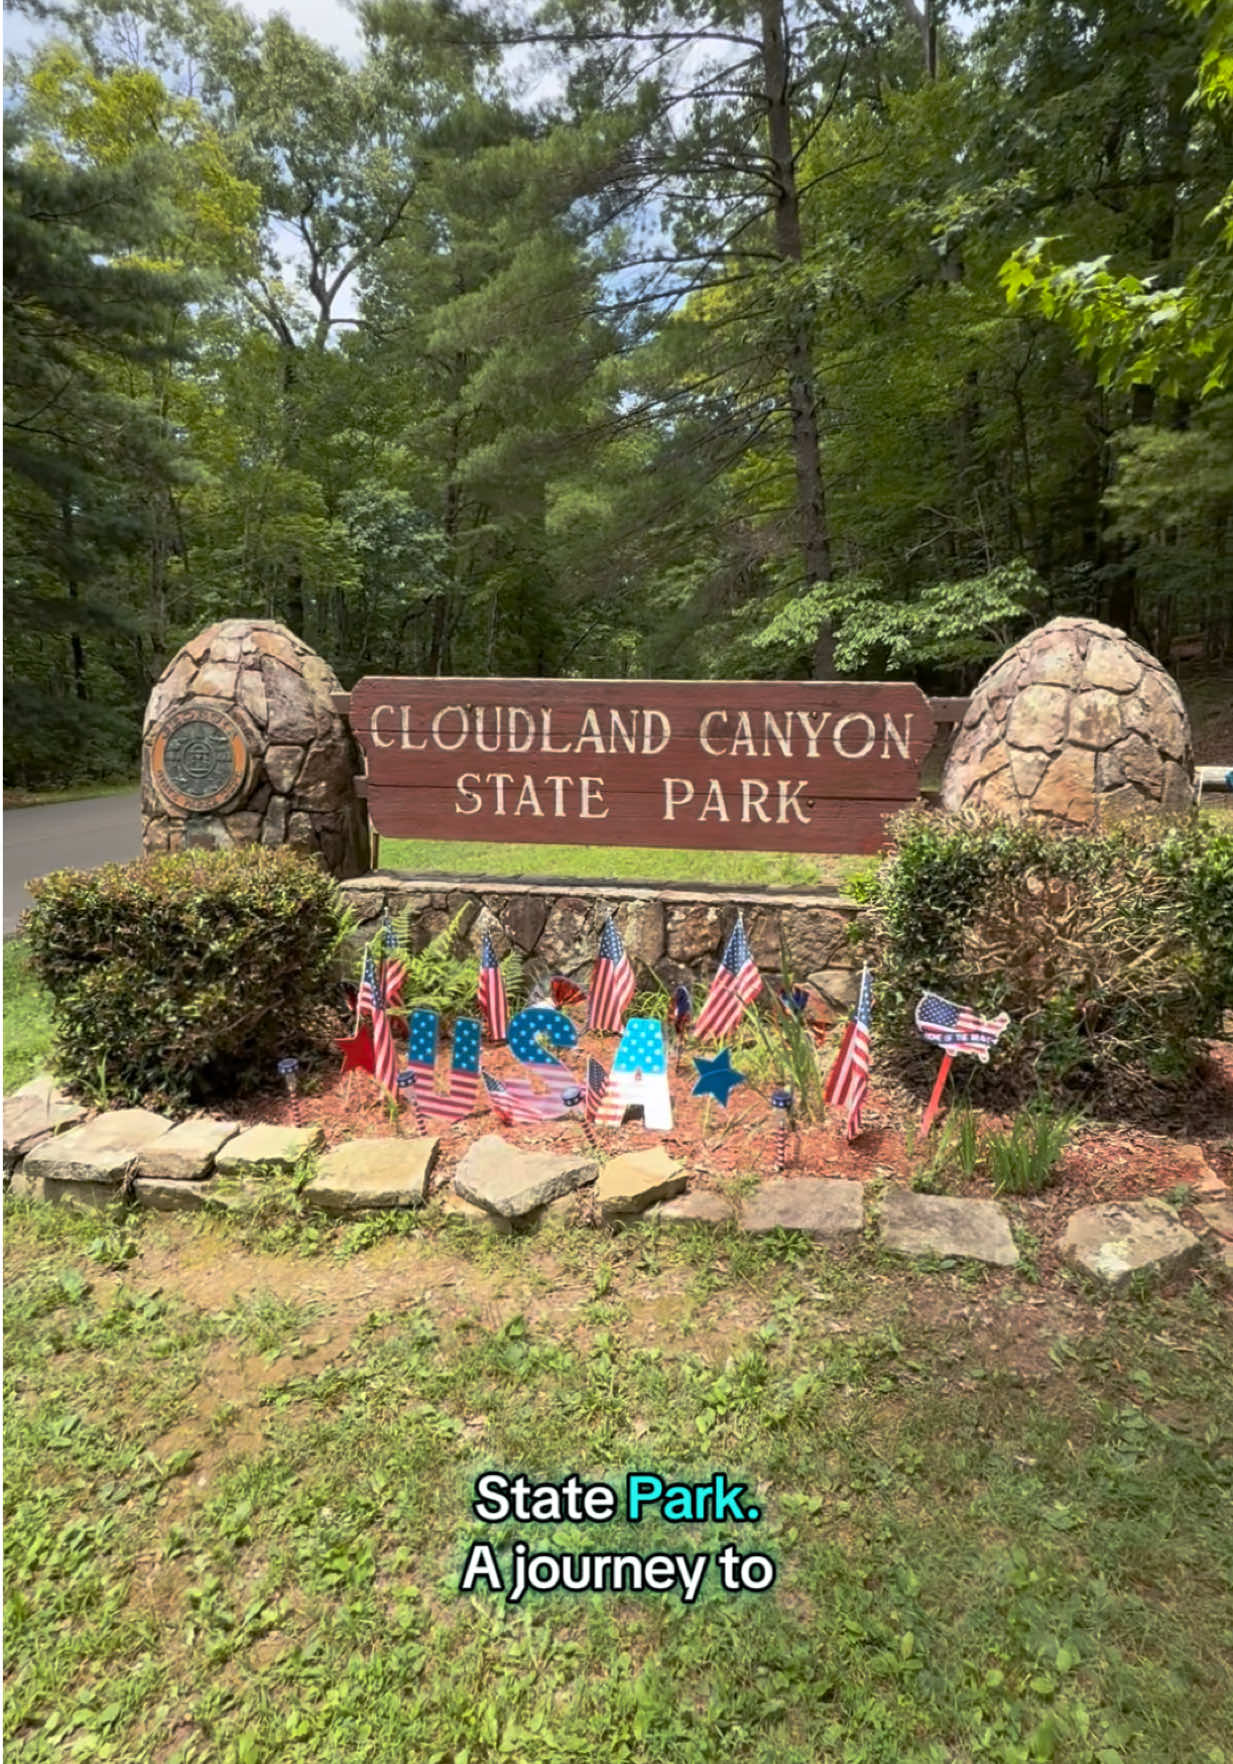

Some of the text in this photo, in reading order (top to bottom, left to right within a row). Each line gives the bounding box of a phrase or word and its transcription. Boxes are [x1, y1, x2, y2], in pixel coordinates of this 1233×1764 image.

[370, 703, 914, 760] CLOUDLAND CANYON
[455, 773, 812, 825] STATE PARK
[407, 1008, 673, 1131] USA
